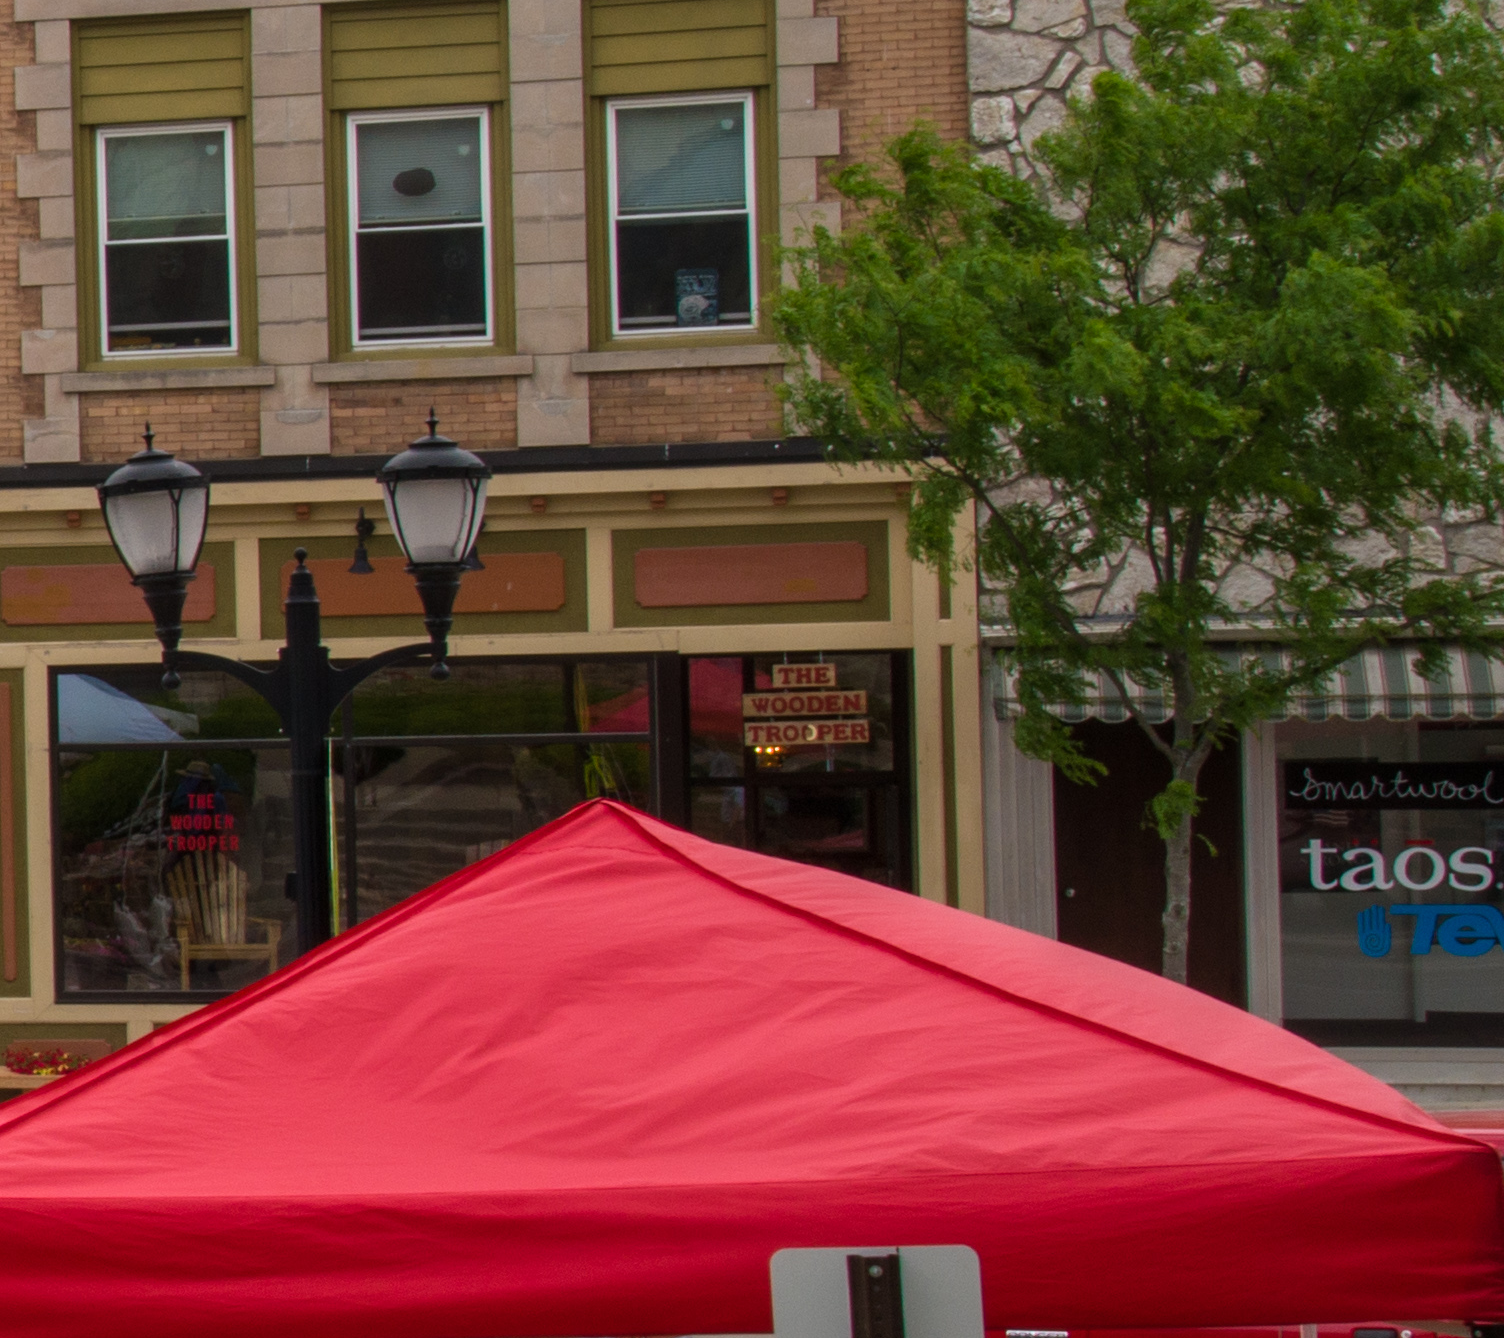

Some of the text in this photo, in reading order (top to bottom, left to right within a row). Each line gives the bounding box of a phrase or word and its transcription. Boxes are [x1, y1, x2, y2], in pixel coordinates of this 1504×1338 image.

[777, 667, 830, 685] THE
[751, 694, 861, 714] WOODEN
[748, 723, 867, 743] TROOPER
[188, 794, 215, 809] THE
[170, 814, 235, 831] WOODEN
[166, 835, 240, 851] TROOPER
